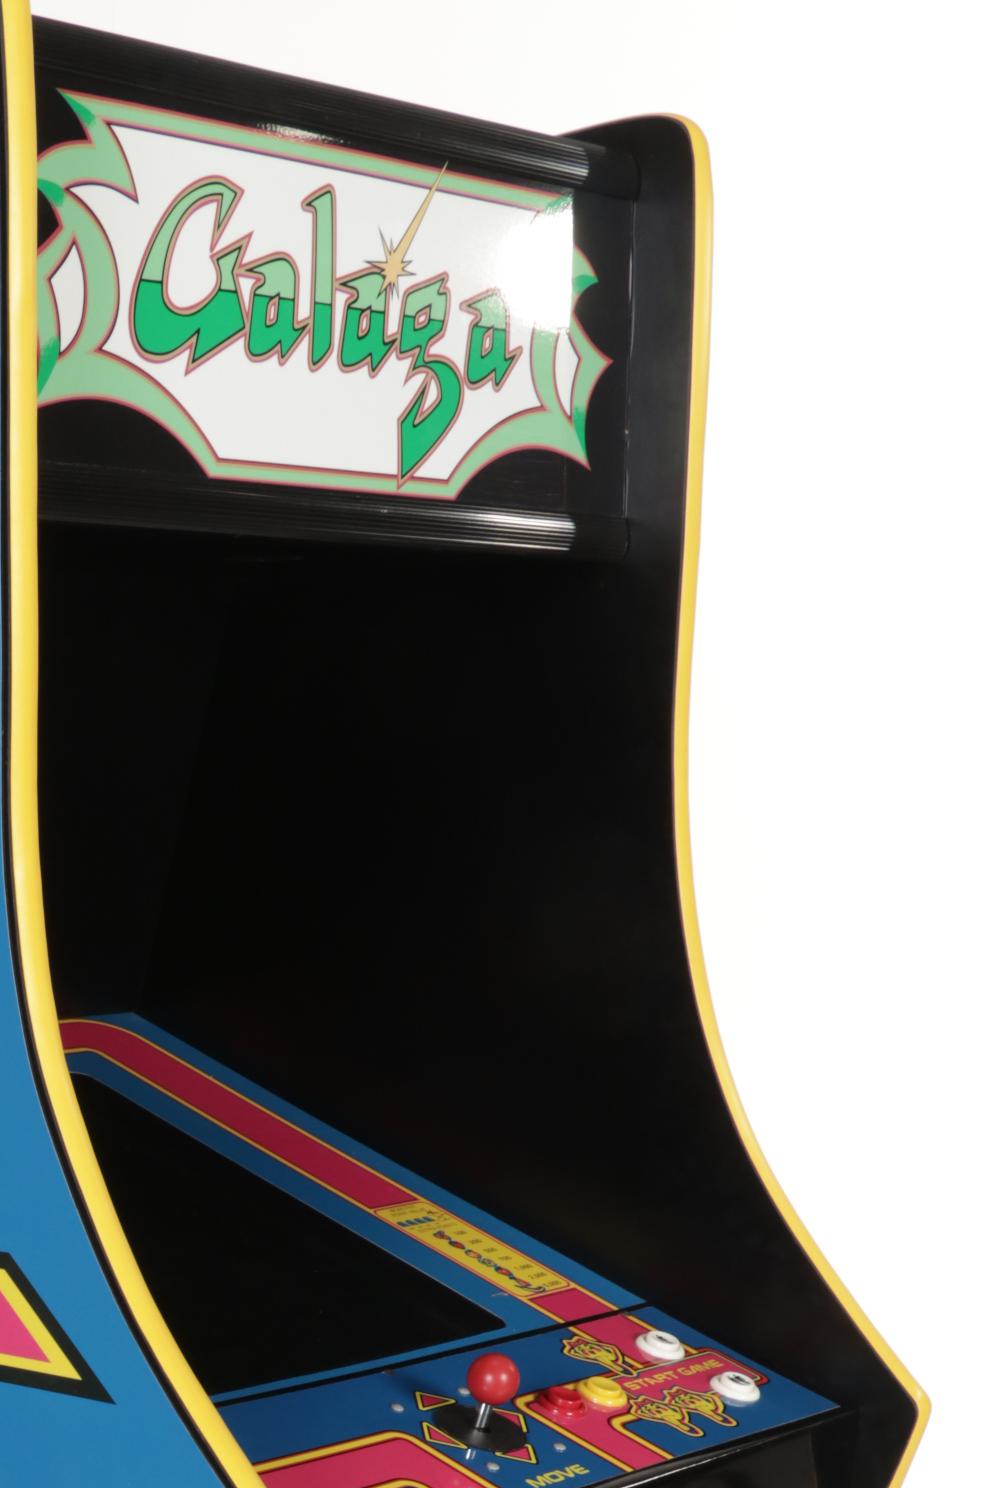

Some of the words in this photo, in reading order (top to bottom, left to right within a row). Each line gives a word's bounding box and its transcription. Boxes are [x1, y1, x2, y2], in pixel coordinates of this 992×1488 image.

[129, 174, 523, 489] Galaga
[623, 1370, 679, 1391] START
[676, 1359, 724, 1377] GAME
[525, 1463, 590, 1488] MOVE
